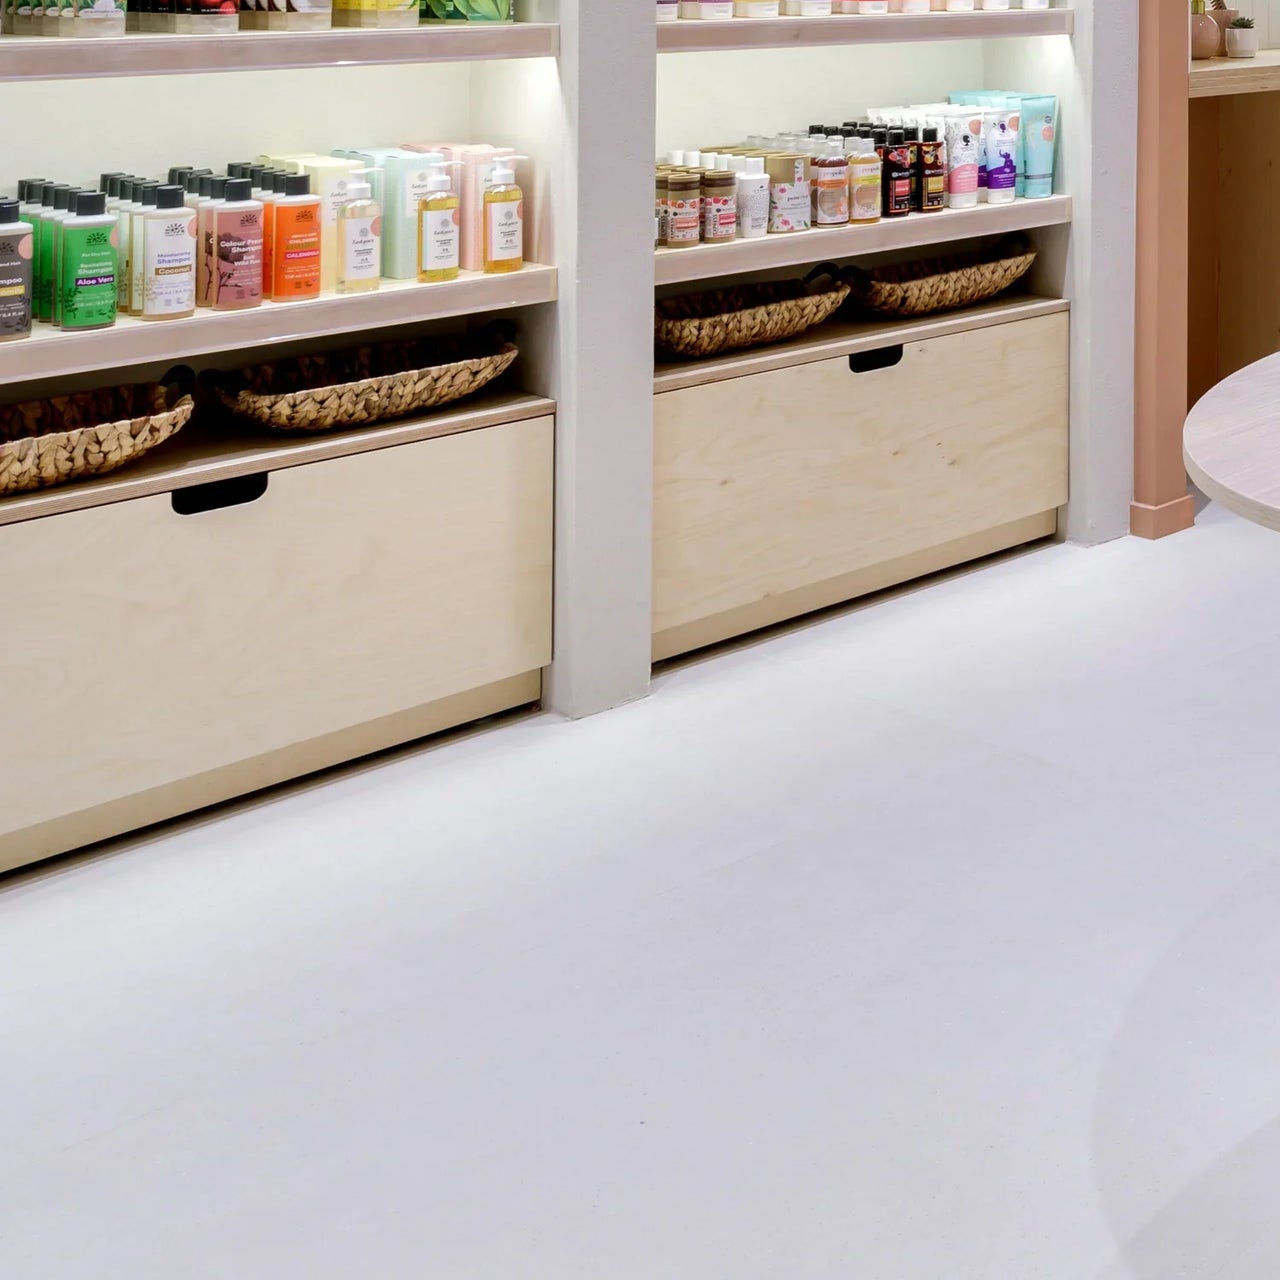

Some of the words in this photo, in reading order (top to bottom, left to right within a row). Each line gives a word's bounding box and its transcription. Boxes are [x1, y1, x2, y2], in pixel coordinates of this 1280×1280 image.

[286, 251, 320, 259] CALENDULA
[157, 257, 191, 265] Shampoo
[158, 267, 190, 275] Coconut
[77, 278, 96, 286] Aloe
